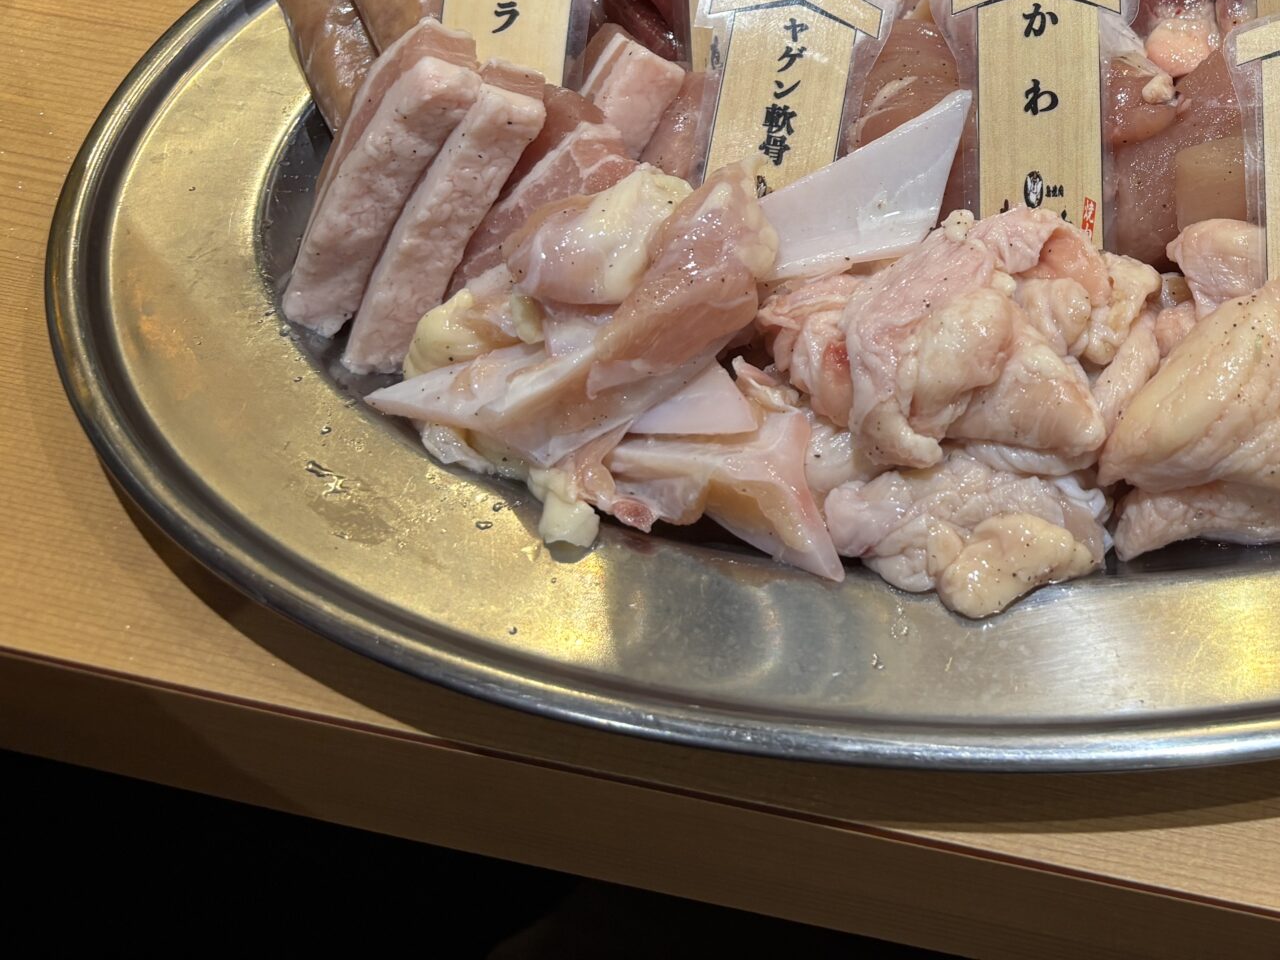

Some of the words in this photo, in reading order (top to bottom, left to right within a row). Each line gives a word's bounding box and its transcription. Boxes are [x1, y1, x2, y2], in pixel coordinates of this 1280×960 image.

[758, 17, 809, 167] ヤゲン軟骨
[1022, 2, 1059, 116] かわ
